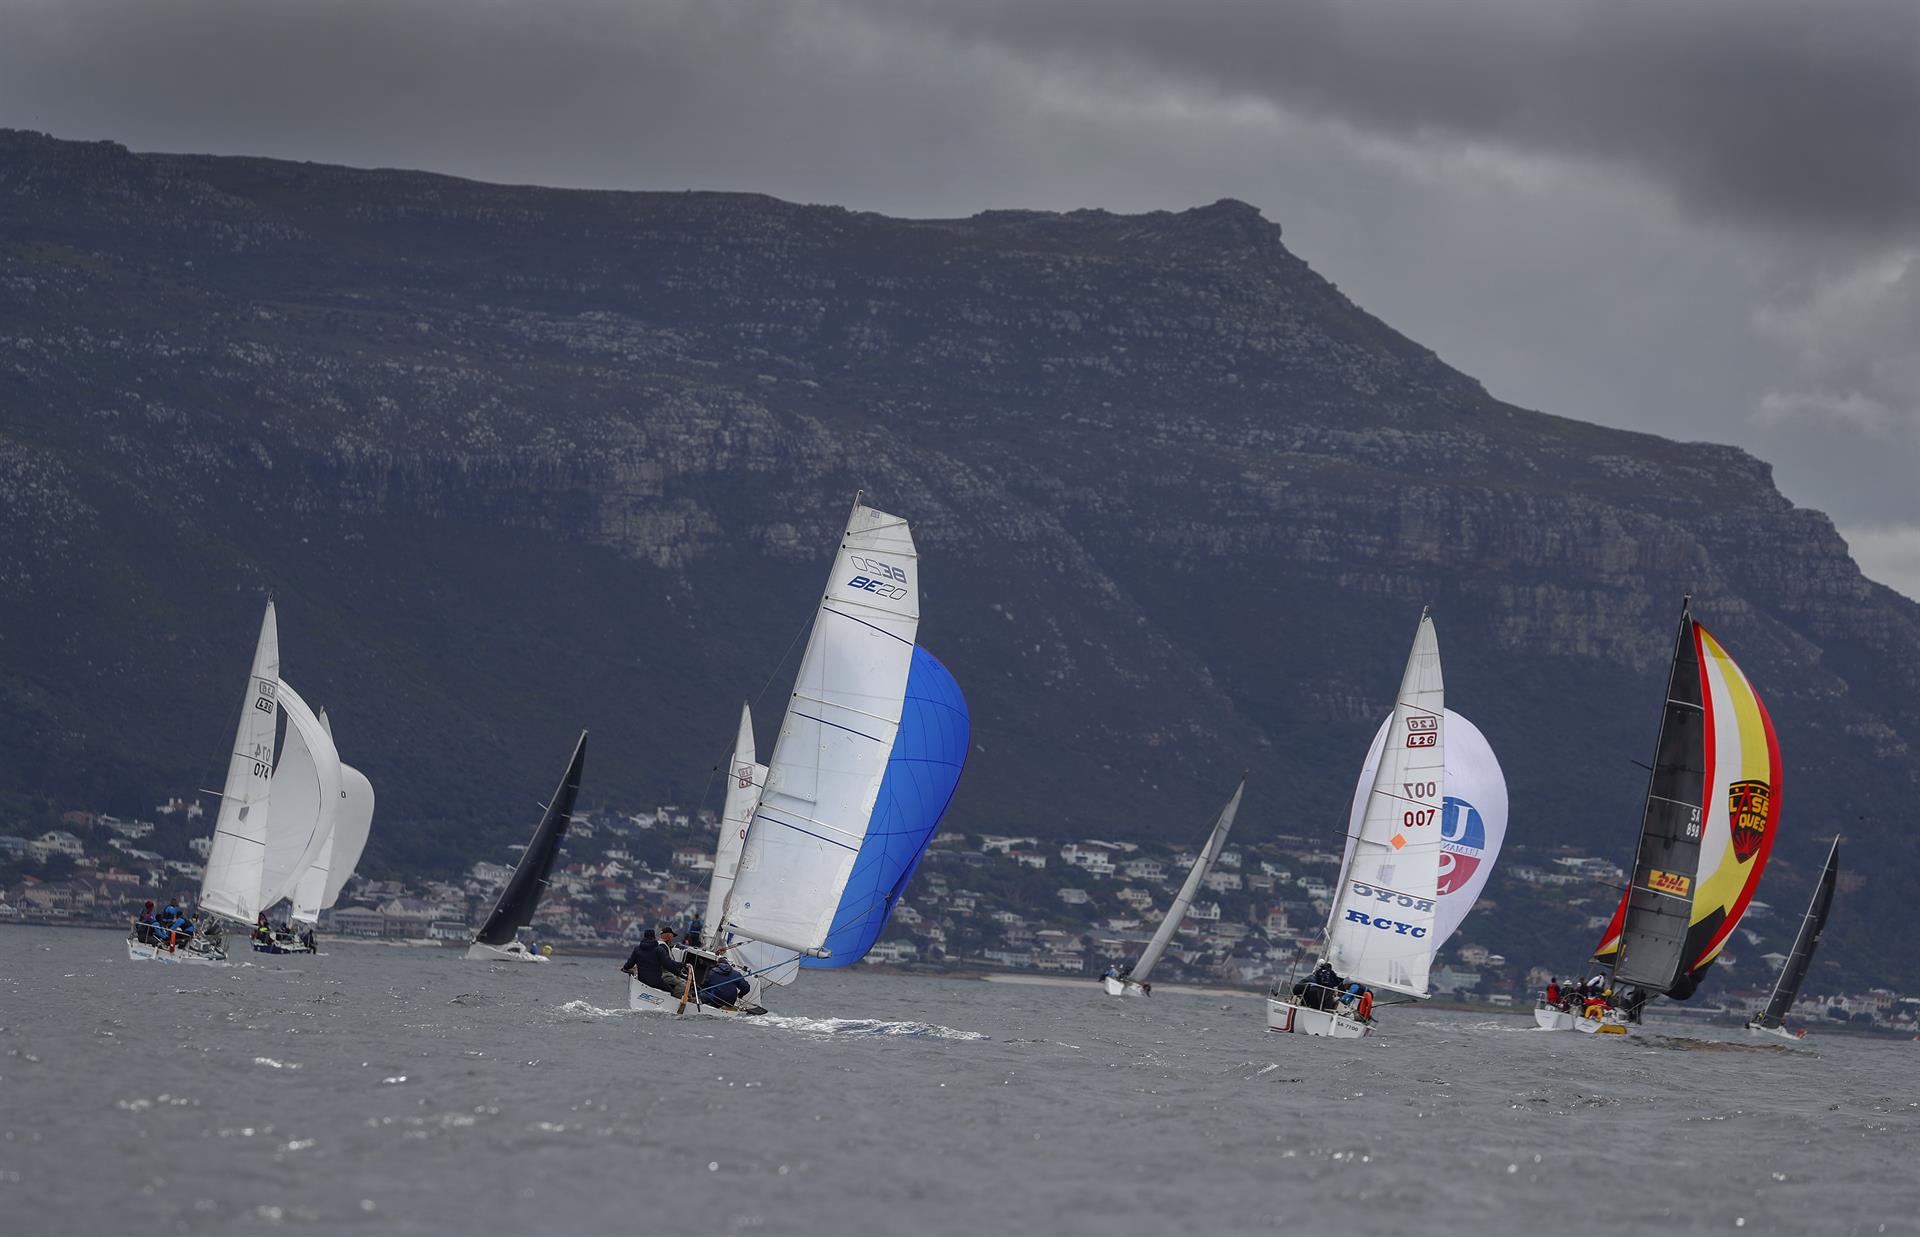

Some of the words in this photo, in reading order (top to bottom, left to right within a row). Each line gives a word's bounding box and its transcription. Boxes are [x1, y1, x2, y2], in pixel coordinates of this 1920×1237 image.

[847, 576, 908, 600] BE20
[1410, 736, 1434, 745] L26
[253, 762, 269, 780] 074
[1404, 809, 1436, 828] 007
[1656, 874, 1685, 892] DHL
[1345, 909, 1427, 938] RCYC
